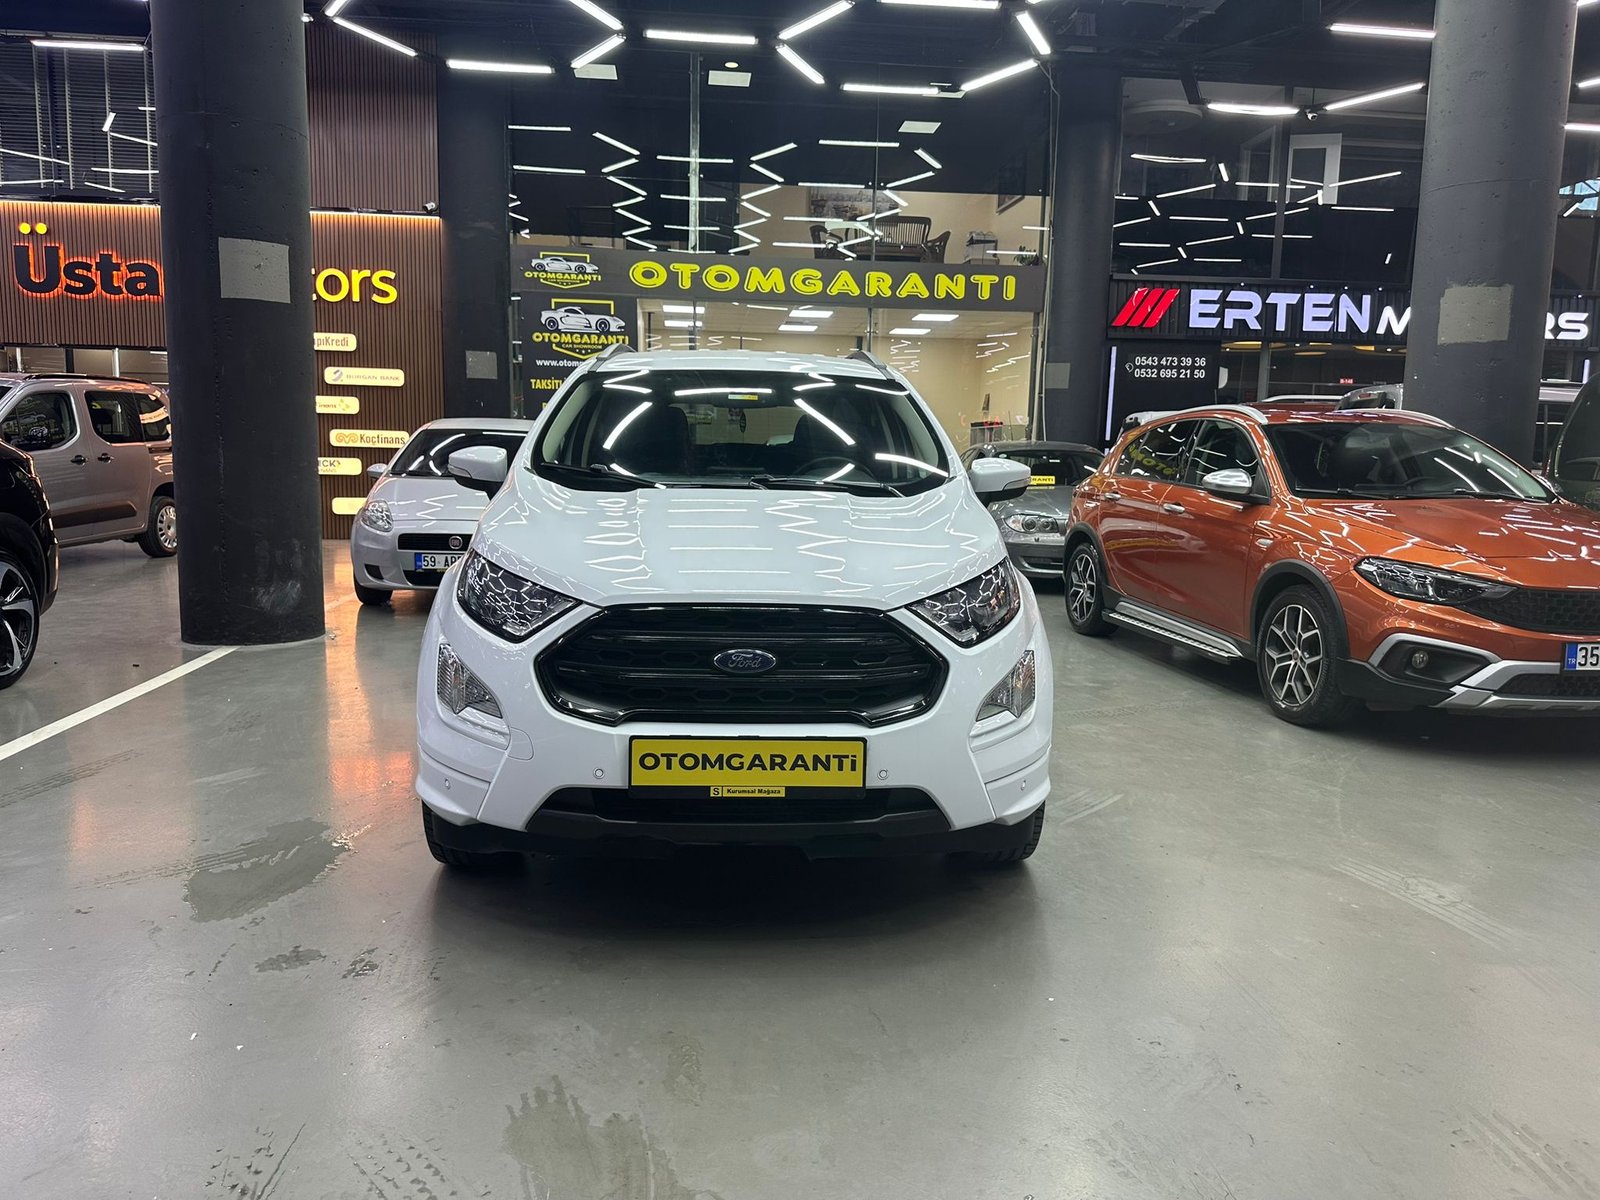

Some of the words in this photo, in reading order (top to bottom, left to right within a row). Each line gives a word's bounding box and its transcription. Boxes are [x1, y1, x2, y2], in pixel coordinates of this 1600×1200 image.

[13, 222, 161, 297] Üsta
[312, 267, 398, 305] ors
[524, 271, 602, 281] OTOMGARANTI
[629, 260, 1016, 301] OTOMGARANTI
[1188, 288, 1372, 334] ERTEN
[532, 332, 630, 345] OTOMGARANTI
[1134, 356, 1158, 366] 0543
[1160, 357, 1178, 366] 473
[1180, 357, 1192, 367] 39
[1194, 357, 1206, 367] 36
[1134, 368, 1158, 378] 0532
[1160, 369, 1178, 378] 695
[1179, 369, 1191, 378] 21
[1193, 369, 1206, 379] 50
[359, 433, 406, 446] Koçfinans
[423, 555, 436, 567] 59
[728, 653, 762, 668] Ford
[1577, 646, 1600, 667] 35
